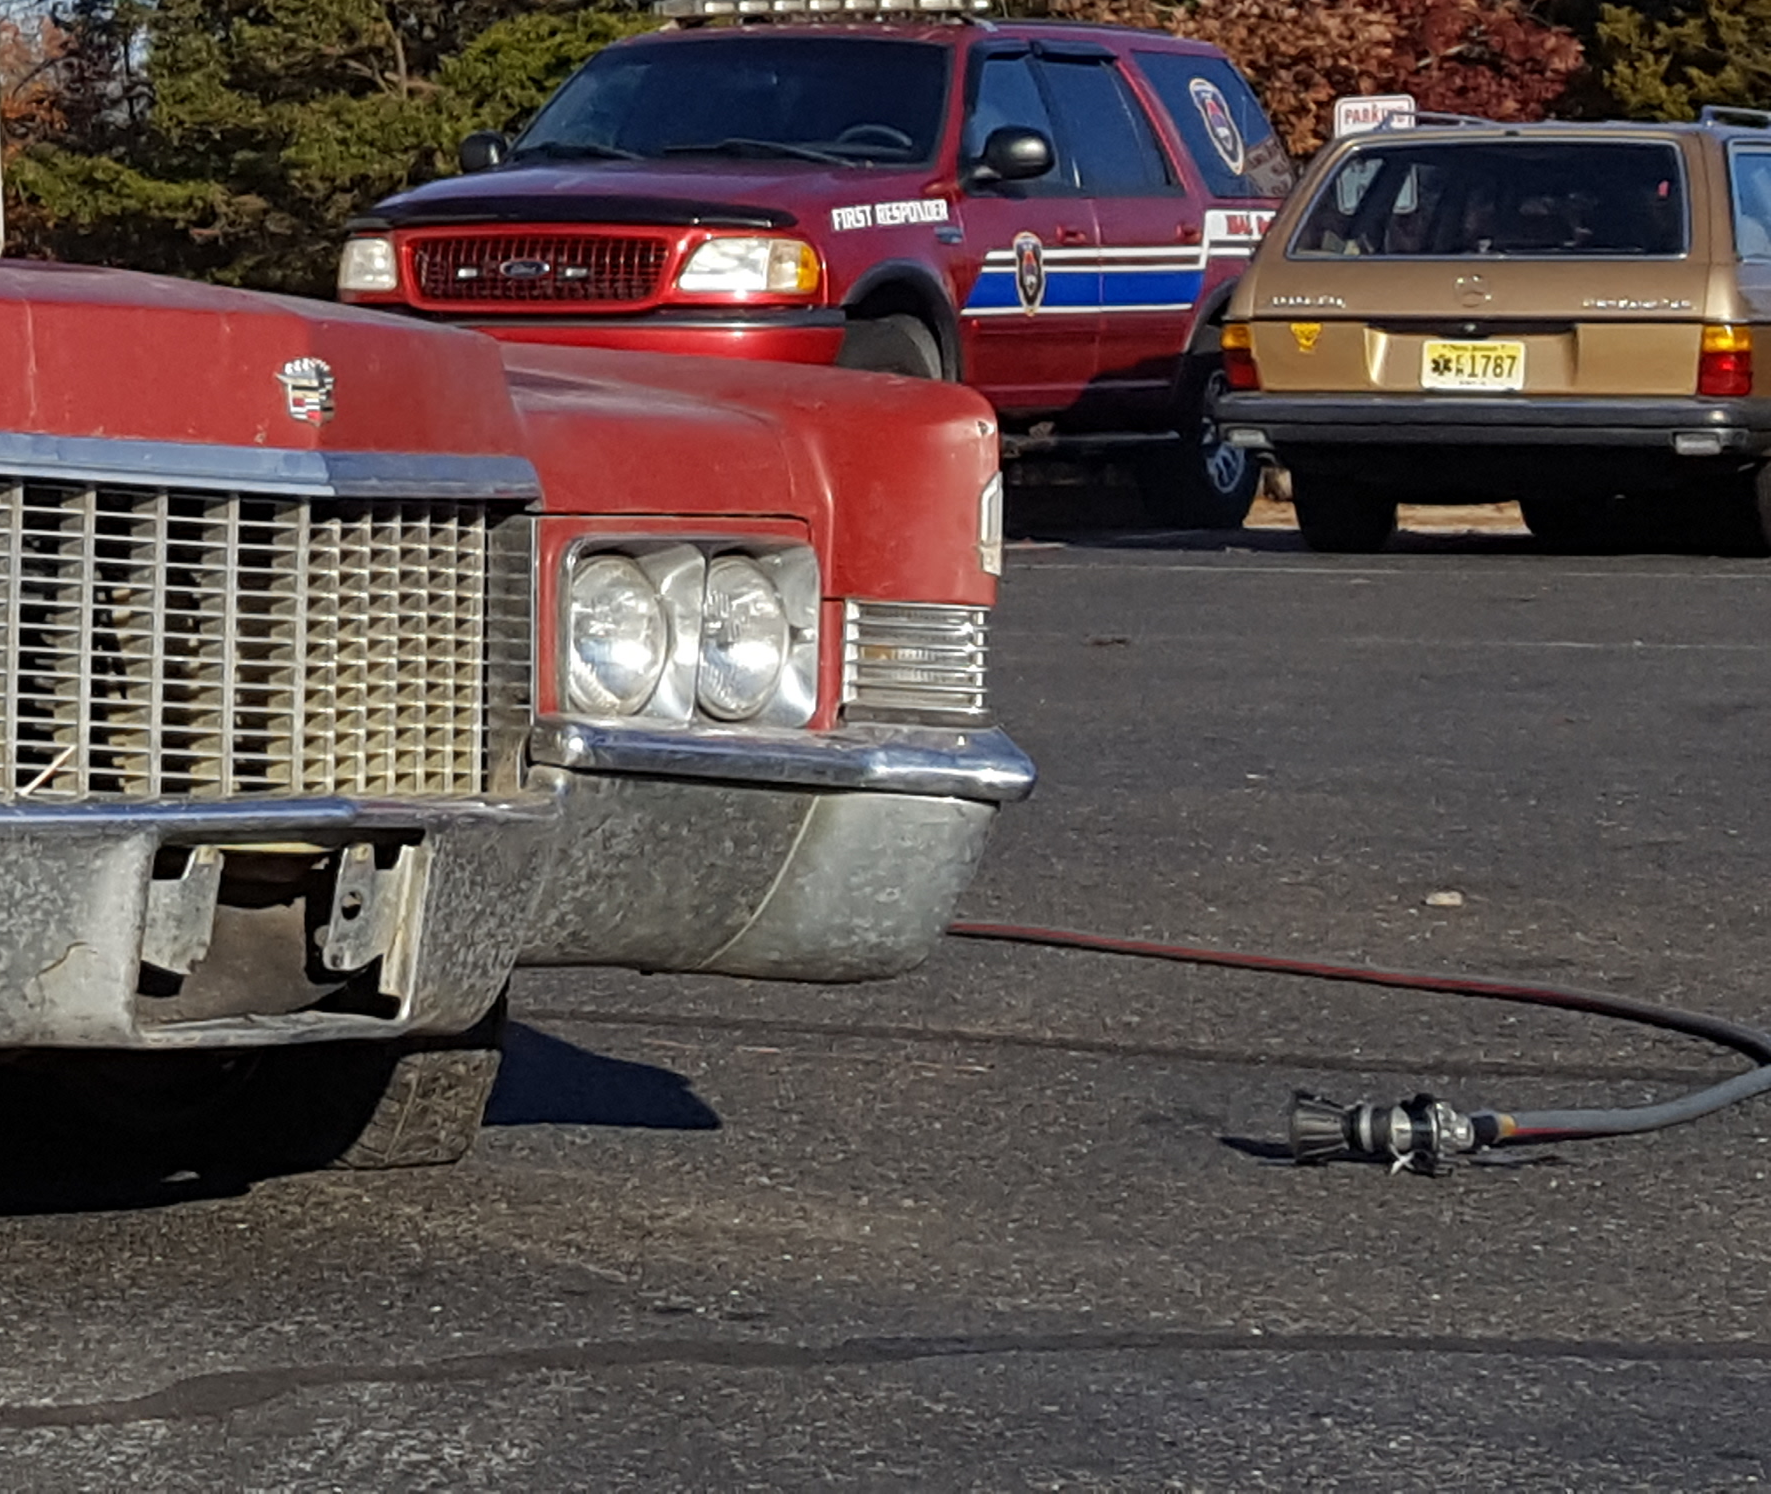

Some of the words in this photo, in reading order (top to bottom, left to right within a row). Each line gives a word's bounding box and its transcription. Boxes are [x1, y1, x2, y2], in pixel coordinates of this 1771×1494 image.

[831, 204, 872, 231] FIRST
[874, 198, 949, 225] RESPONDER
[1467, 354, 1517, 379] 1787
